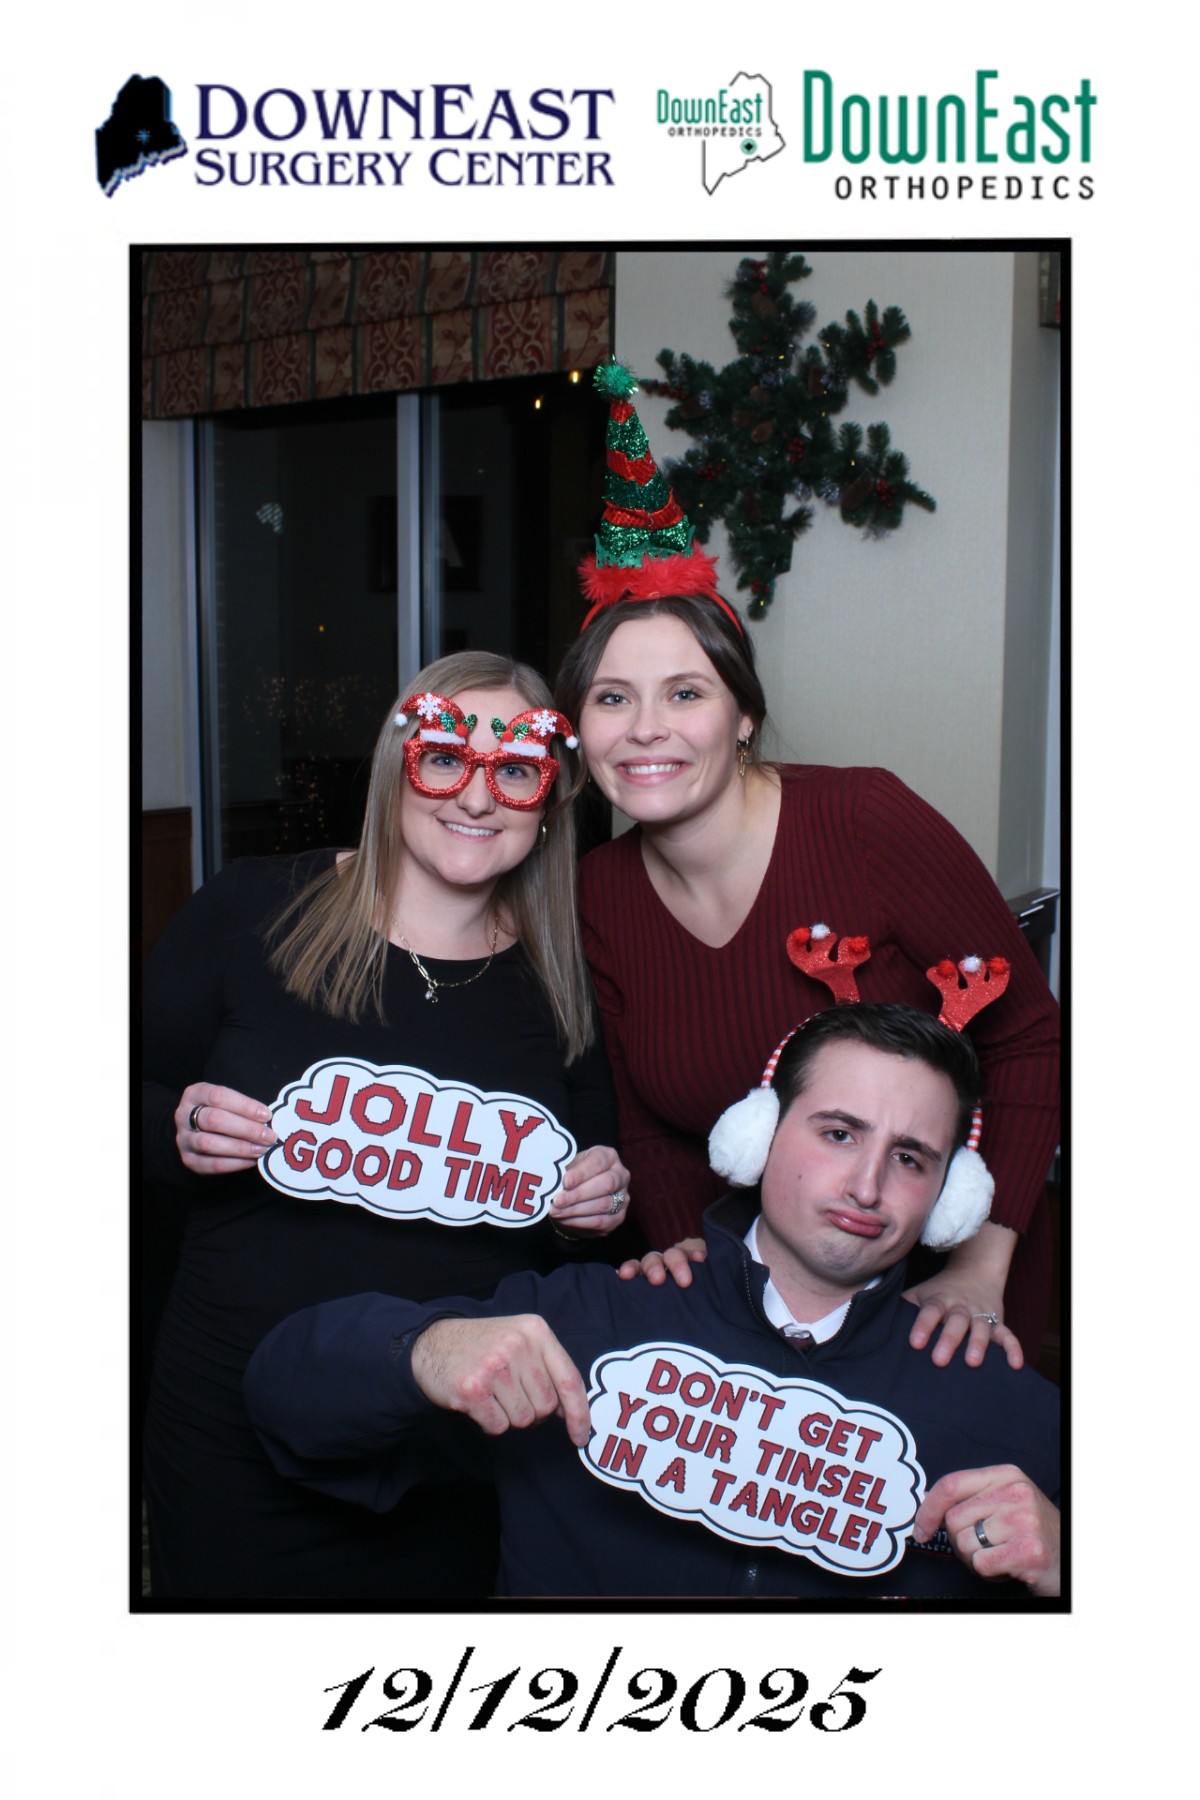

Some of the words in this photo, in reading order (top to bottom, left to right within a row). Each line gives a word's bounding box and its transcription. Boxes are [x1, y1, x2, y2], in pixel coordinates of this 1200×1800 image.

[294, 1074, 545, 1164] JOLLY
[282, 1129, 423, 1190] GOOD
[444, 1156, 543, 1216] TIME
[617, 1391, 738, 1464] YOUR
[755, 1439, 887, 1515] TINSEL
[646, 1358, 786, 1431] DON'T
[798, 1412, 883, 1463] GET
[598, 1433, 648, 1478] IN
[655, 1456, 686, 1494] A
[709, 1469, 883, 1555] TANGLE!
